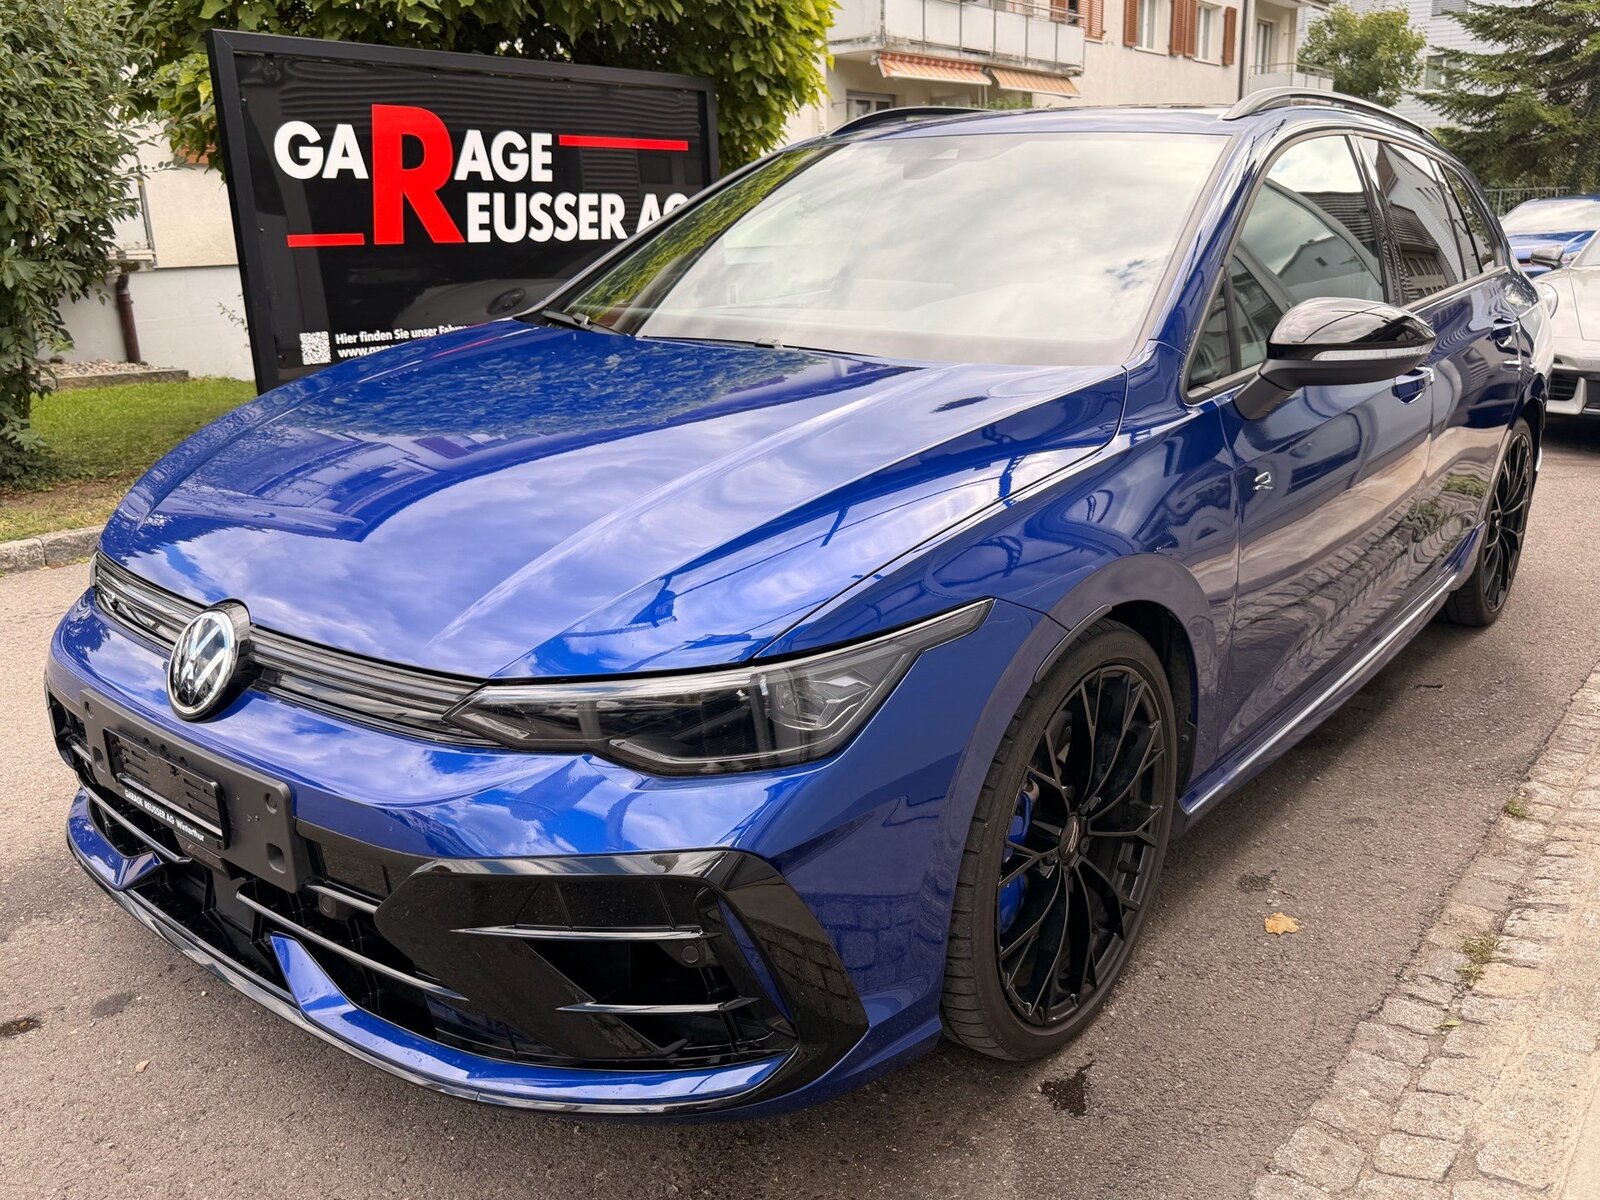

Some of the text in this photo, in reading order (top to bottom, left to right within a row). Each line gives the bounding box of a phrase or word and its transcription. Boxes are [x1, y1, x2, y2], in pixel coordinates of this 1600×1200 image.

[273, 104, 553, 245] GARAGE
[335, 333, 358, 345] Hier
[359, 330, 393, 342] finden
[393, 328, 409, 340] Sie
[411, 328, 437, 338] unser
[124, 789, 143, 807] GARAGE
[143, 800, 166, 820] REUSSER
[166, 813, 175, 825] AG
